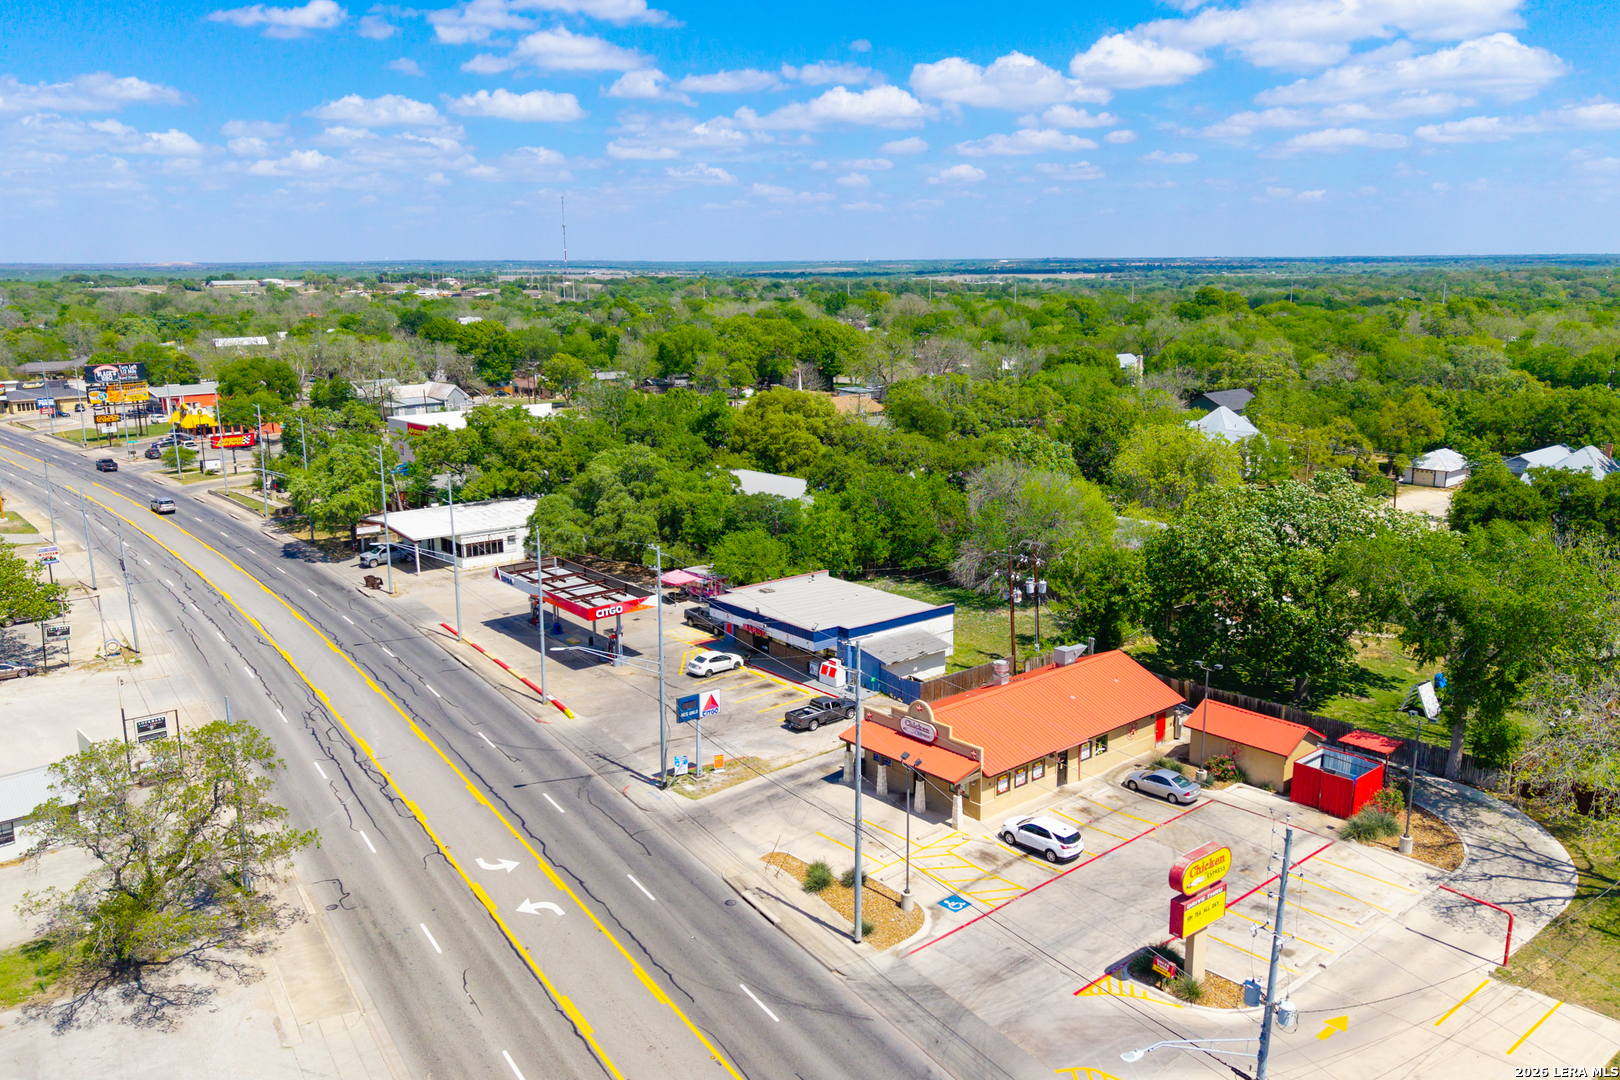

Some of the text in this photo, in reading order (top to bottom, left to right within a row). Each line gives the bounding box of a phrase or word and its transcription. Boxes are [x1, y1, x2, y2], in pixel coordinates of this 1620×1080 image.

[596, 605, 623, 618] CITGO
[702, 708, 719, 717] CITGO
[905, 719, 930, 734] Chicken
[1190, 855, 1226, 878] Chicken
[1206, 866, 1226, 879] EXPRESS
[1187, 887, 1224, 910] DRIVE THRU
[1211, 901, 1220, 909] DAY
